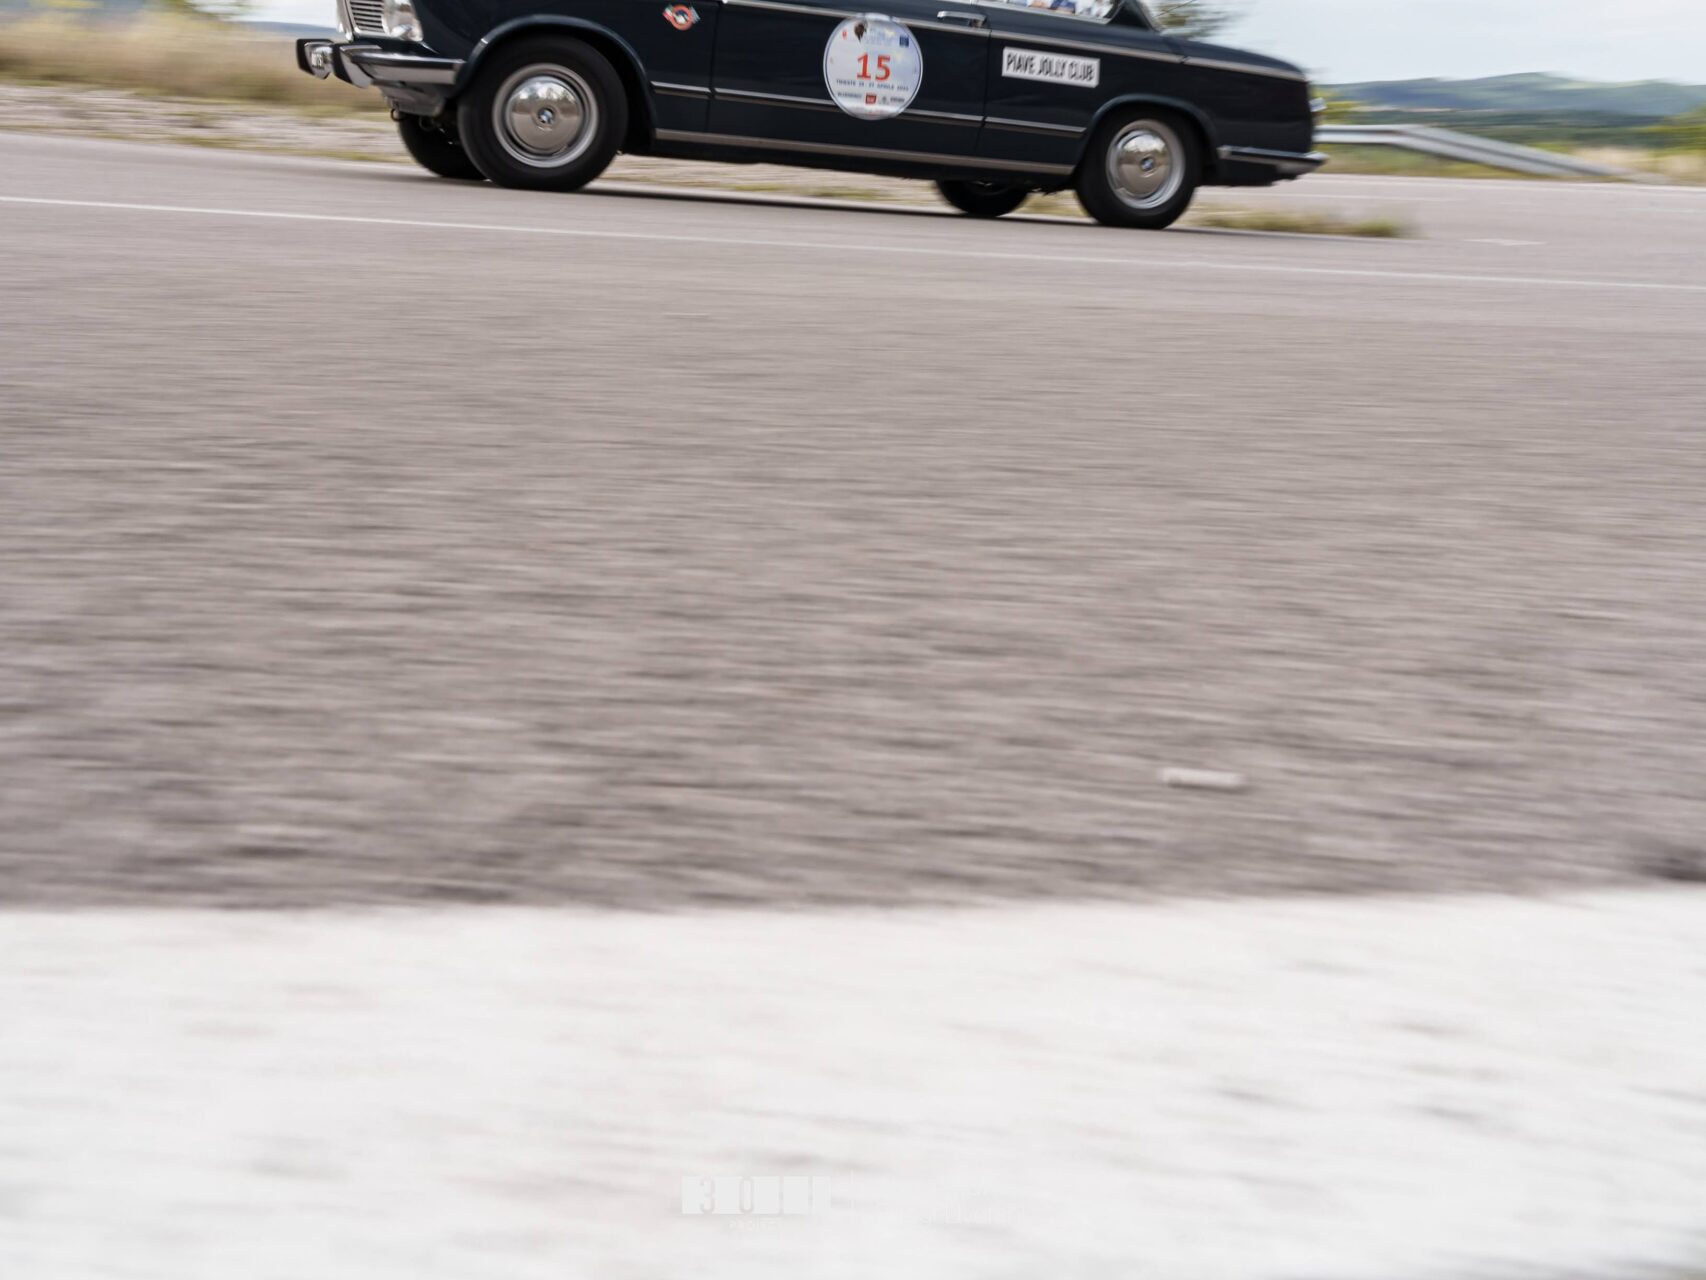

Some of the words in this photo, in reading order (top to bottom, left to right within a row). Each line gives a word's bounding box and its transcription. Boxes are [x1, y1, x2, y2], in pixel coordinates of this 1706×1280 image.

[857, 53, 890, 81] 15
[1006, 52, 1036, 75] PIAVE
[1037, 56, 1067, 78] JOLLY
[1068, 60, 1095, 82] CLUB
